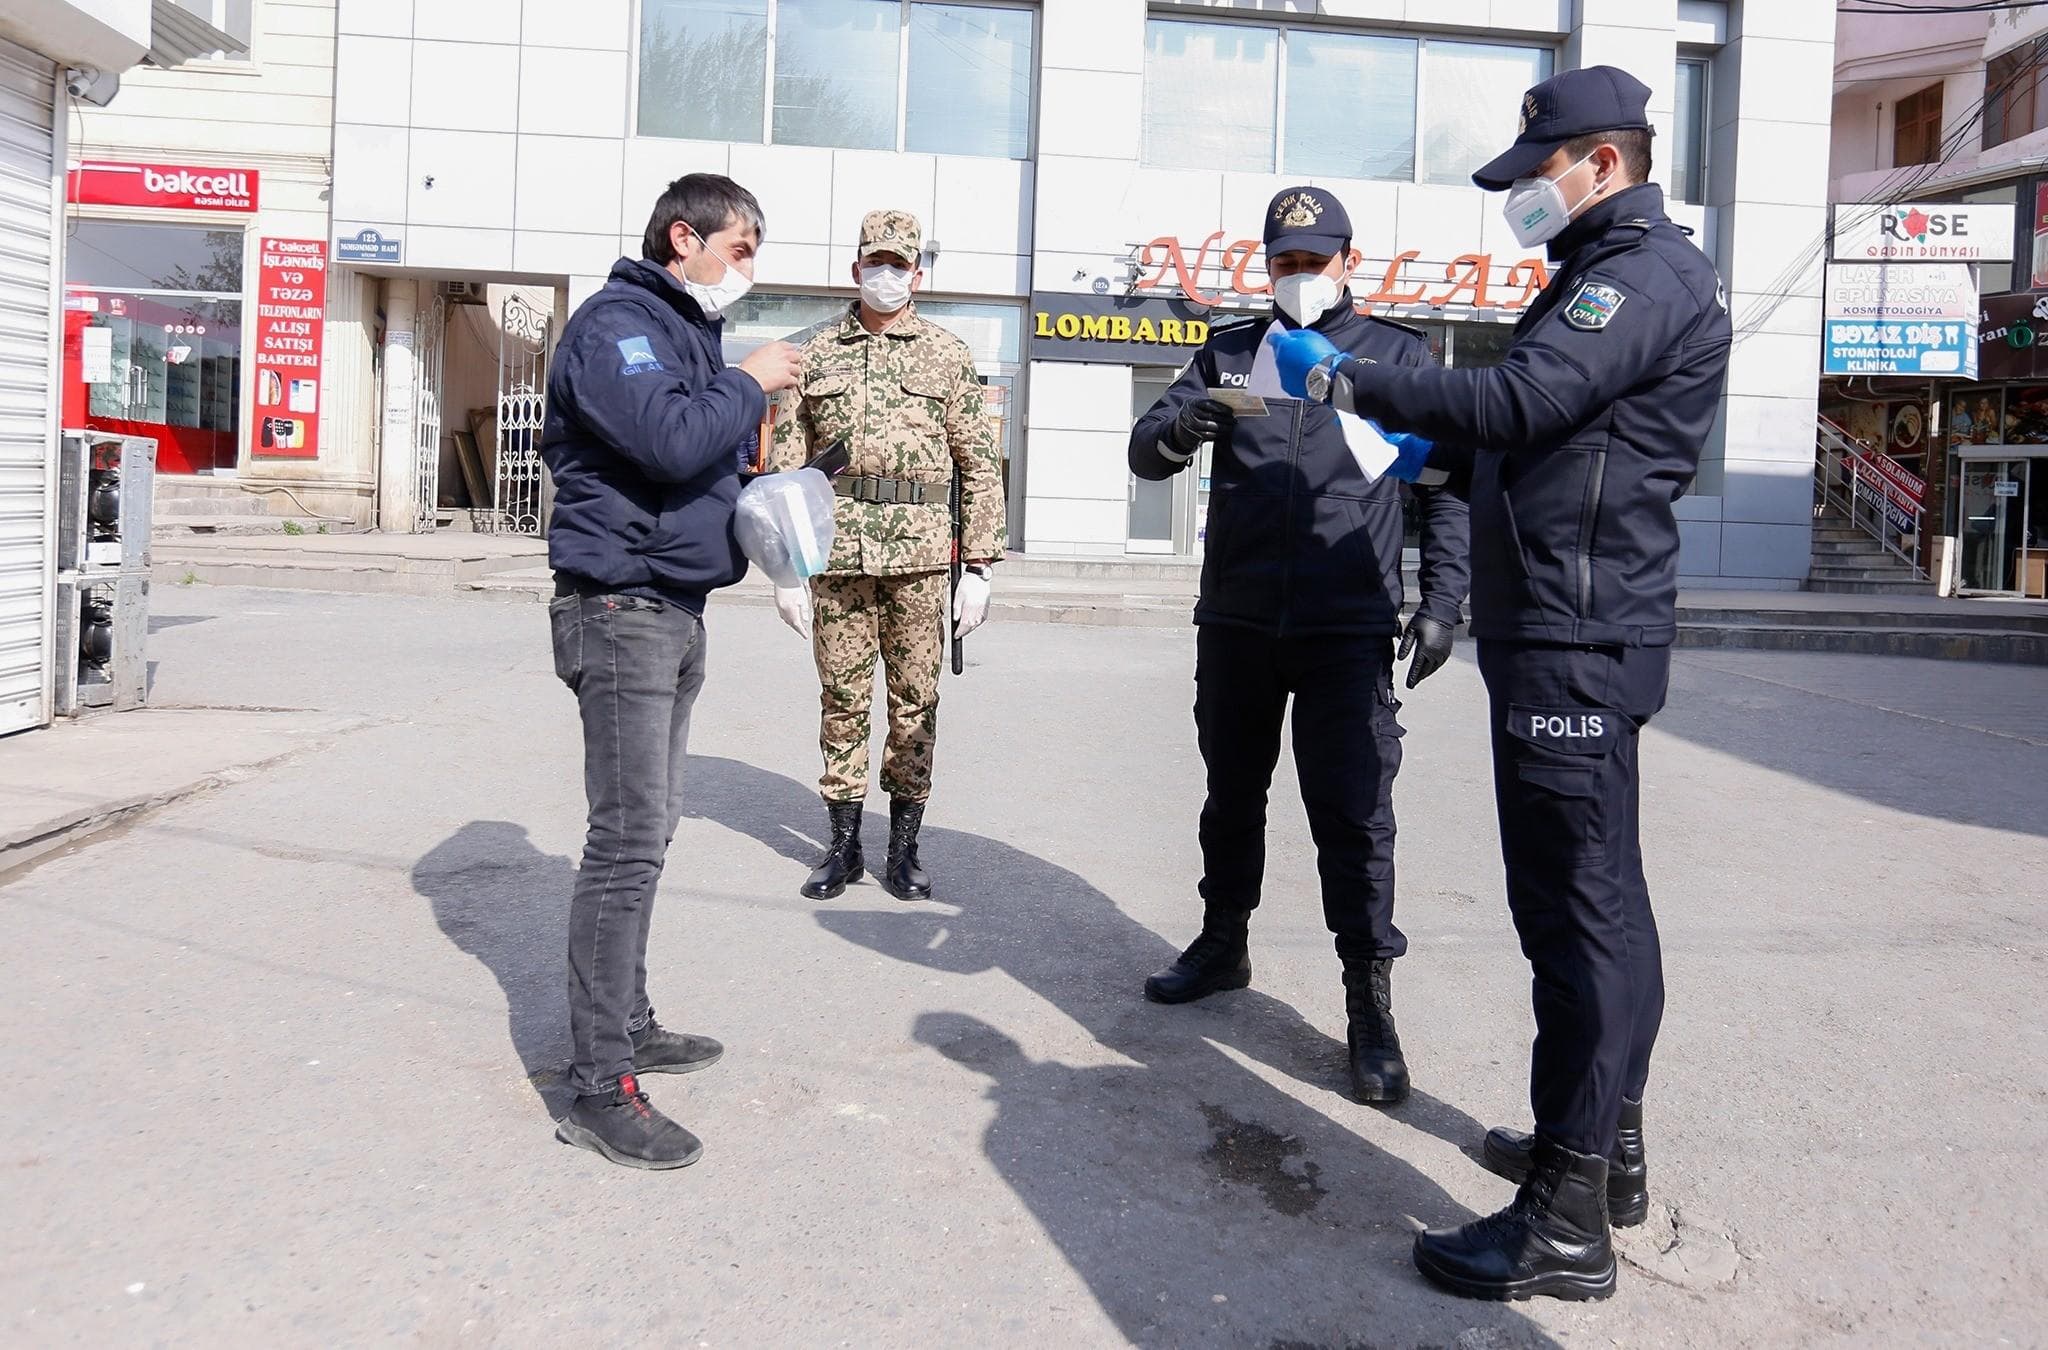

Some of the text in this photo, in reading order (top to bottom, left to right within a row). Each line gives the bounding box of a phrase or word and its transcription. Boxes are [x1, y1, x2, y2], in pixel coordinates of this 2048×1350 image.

[144, 168, 250, 197] bakcell
[363, 233, 377, 242] 125
[279, 241, 320, 253] bakcell
[1867, 246, 1914, 257] QADIN
[1138, 231, 1549, 309] NULAN
[1840, 265, 1914, 284] LAZER
[1833, 286, 1958, 304] EPİLYASİYA
[259, 304, 322, 320] TELEFONLARIN
[1843, 306, 1943, 315] KOSMETOLOGİYA
[269, 321, 311, 337] ALIŞI
[1035, 312, 1210, 345] LOMBARD
[1905, 323, 1942, 349] DİŞ
[264, 336, 313, 353] SATIŞI
[1833, 346, 1917, 359] STOMATOLOJİ
[257, 353, 318, 367] BARTERİ
[1847, 359, 1897, 372] KLİNİKA
[1220, 371, 1251, 388] POL
